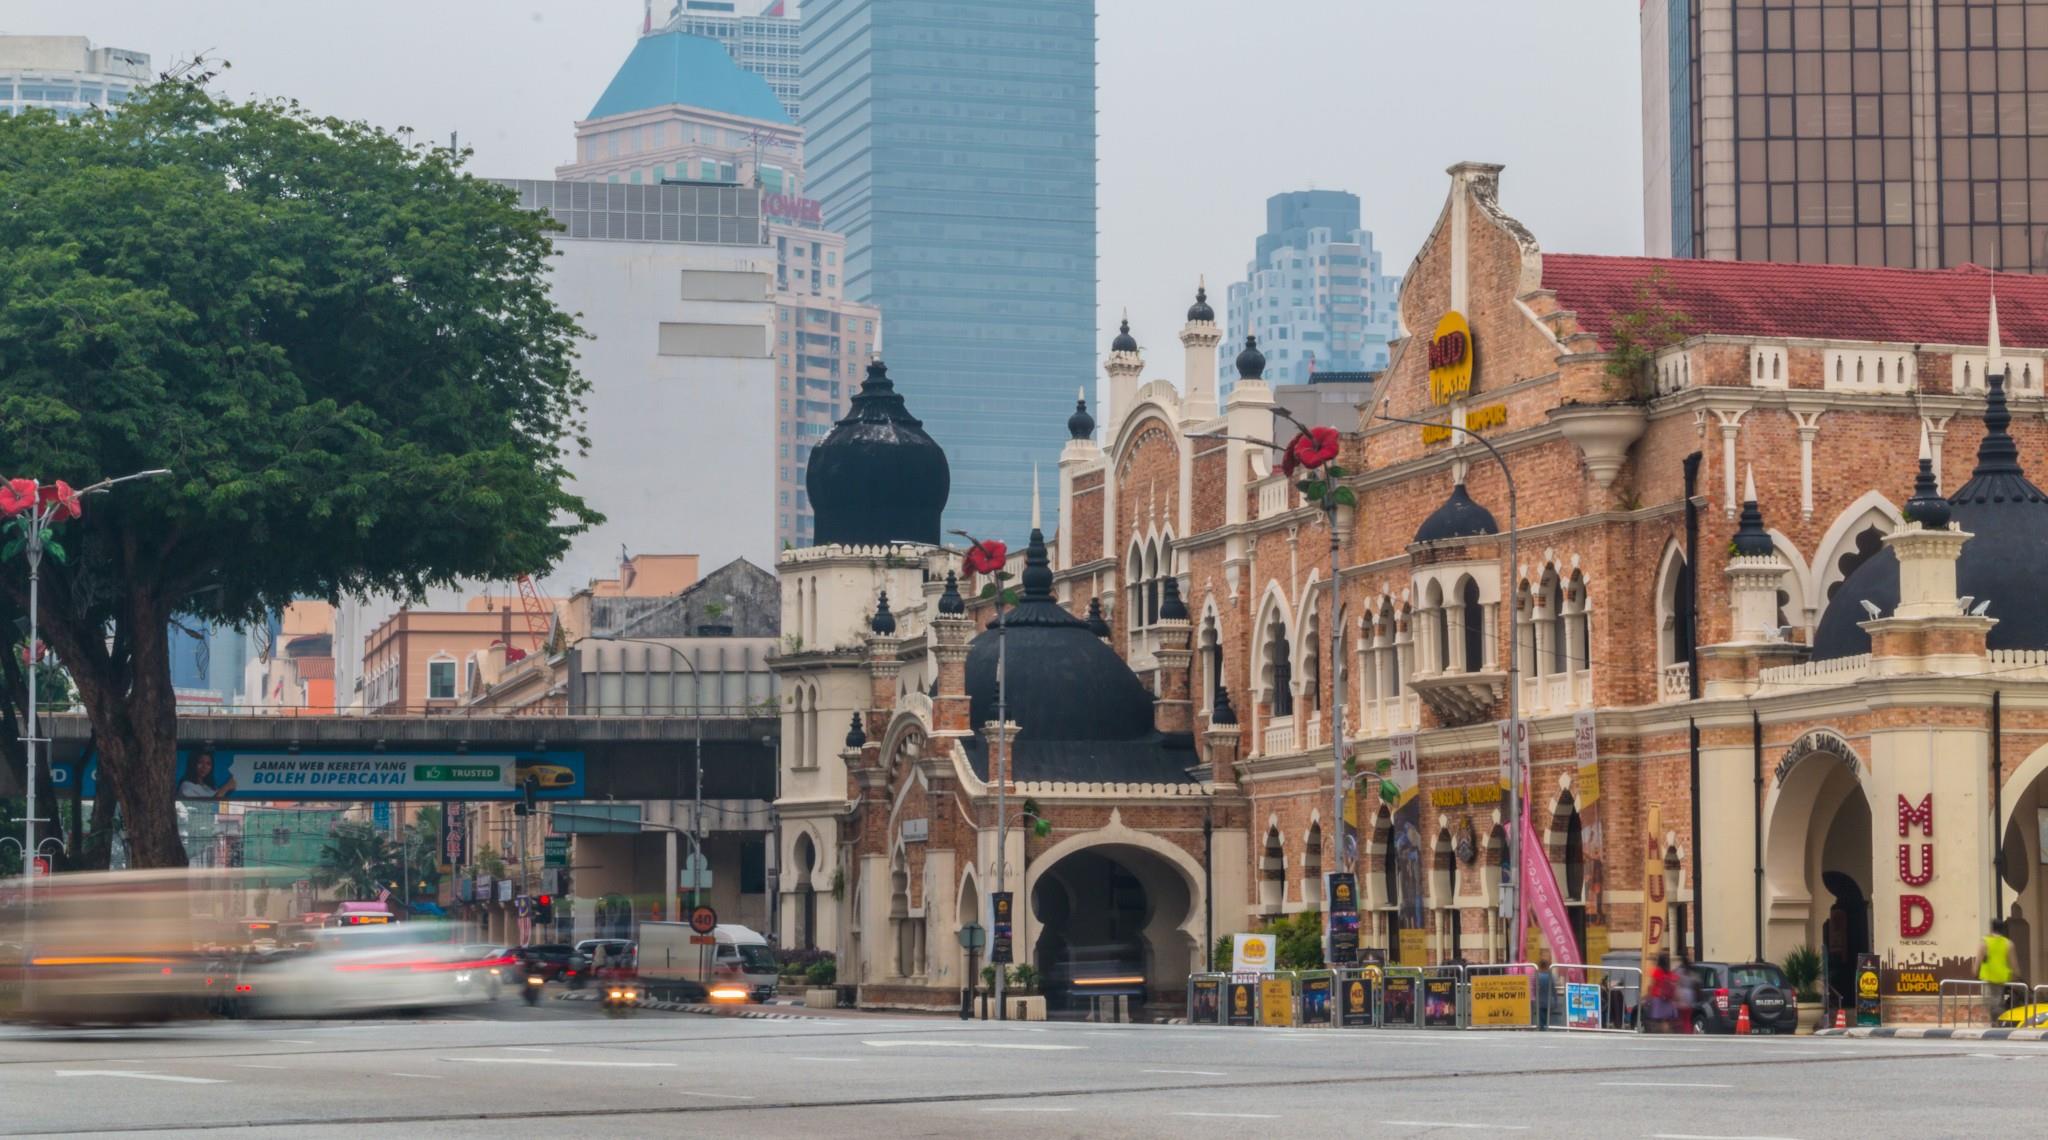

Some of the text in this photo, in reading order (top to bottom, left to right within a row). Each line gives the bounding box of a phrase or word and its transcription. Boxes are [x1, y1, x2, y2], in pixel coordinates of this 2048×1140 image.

[1429, 331, 1465, 370] MUD
[1502, 723, 1525, 744] MD
[253, 761, 407, 771] LAMAN WEB KERETA YANG
[1400, 750, 1415, 771] KL
[253, 772, 406, 784] BOLEH DIPERCAYAI
[452, 769, 494, 777] TRUSTED
[1898, 793, 1934, 938] MUD
[1900, 972, 1934, 982] KUALA
[1897, 982, 1939, 992] LUMPUR
[1474, 991, 1496, 1000] OPEN
